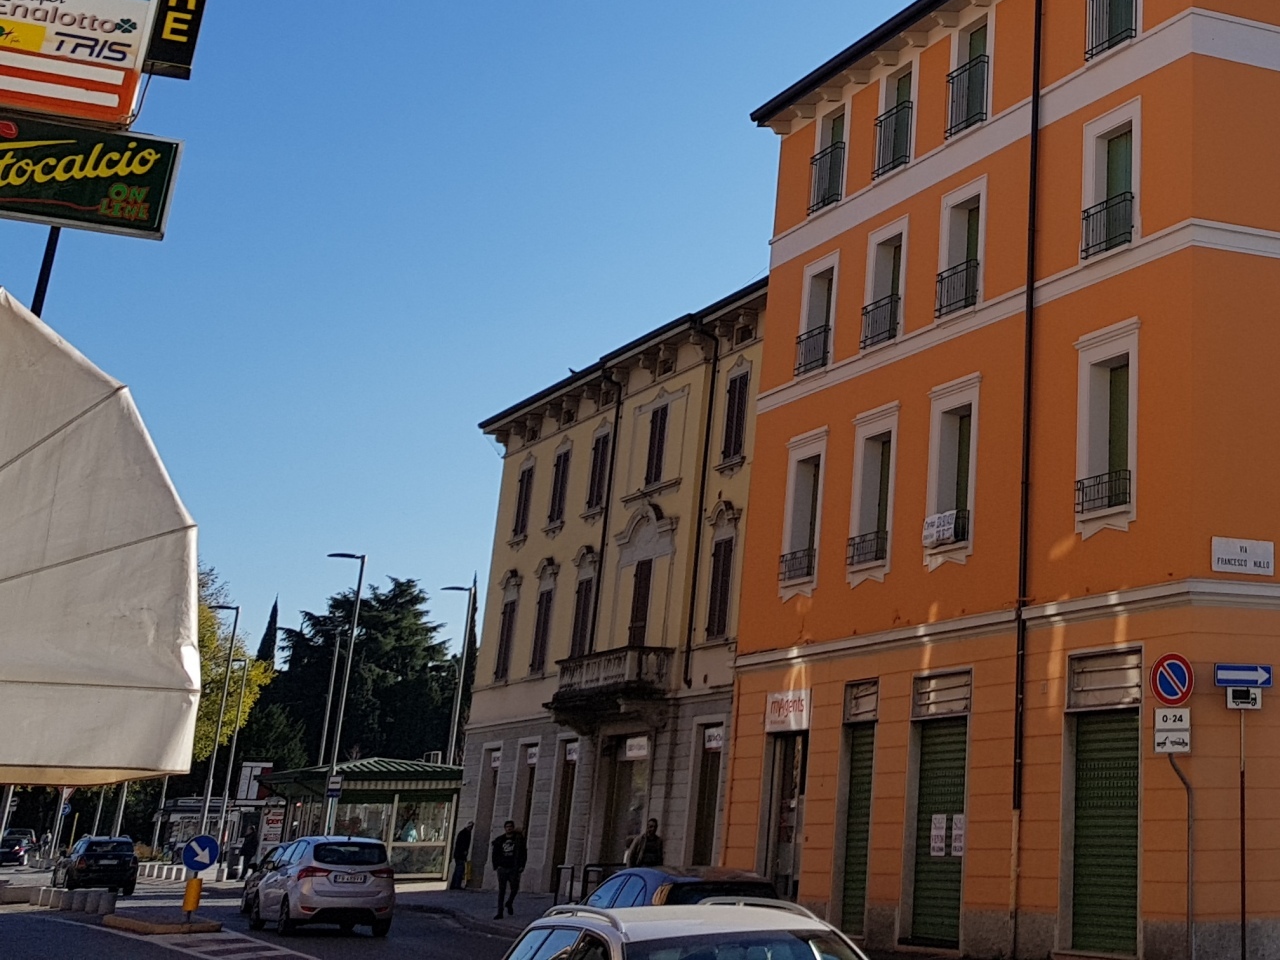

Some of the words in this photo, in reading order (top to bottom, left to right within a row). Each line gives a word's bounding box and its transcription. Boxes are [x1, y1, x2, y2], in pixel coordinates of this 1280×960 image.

[54, 30, 132, 62] TRIS
[110, 183, 150, 202] ON
[98, 198, 150, 220] LINE
[1239, 545, 1248, 553] VIA
[1216, 557, 1248, 567] FRANCESCO
[1253, 560, 1270, 569] NULLO
